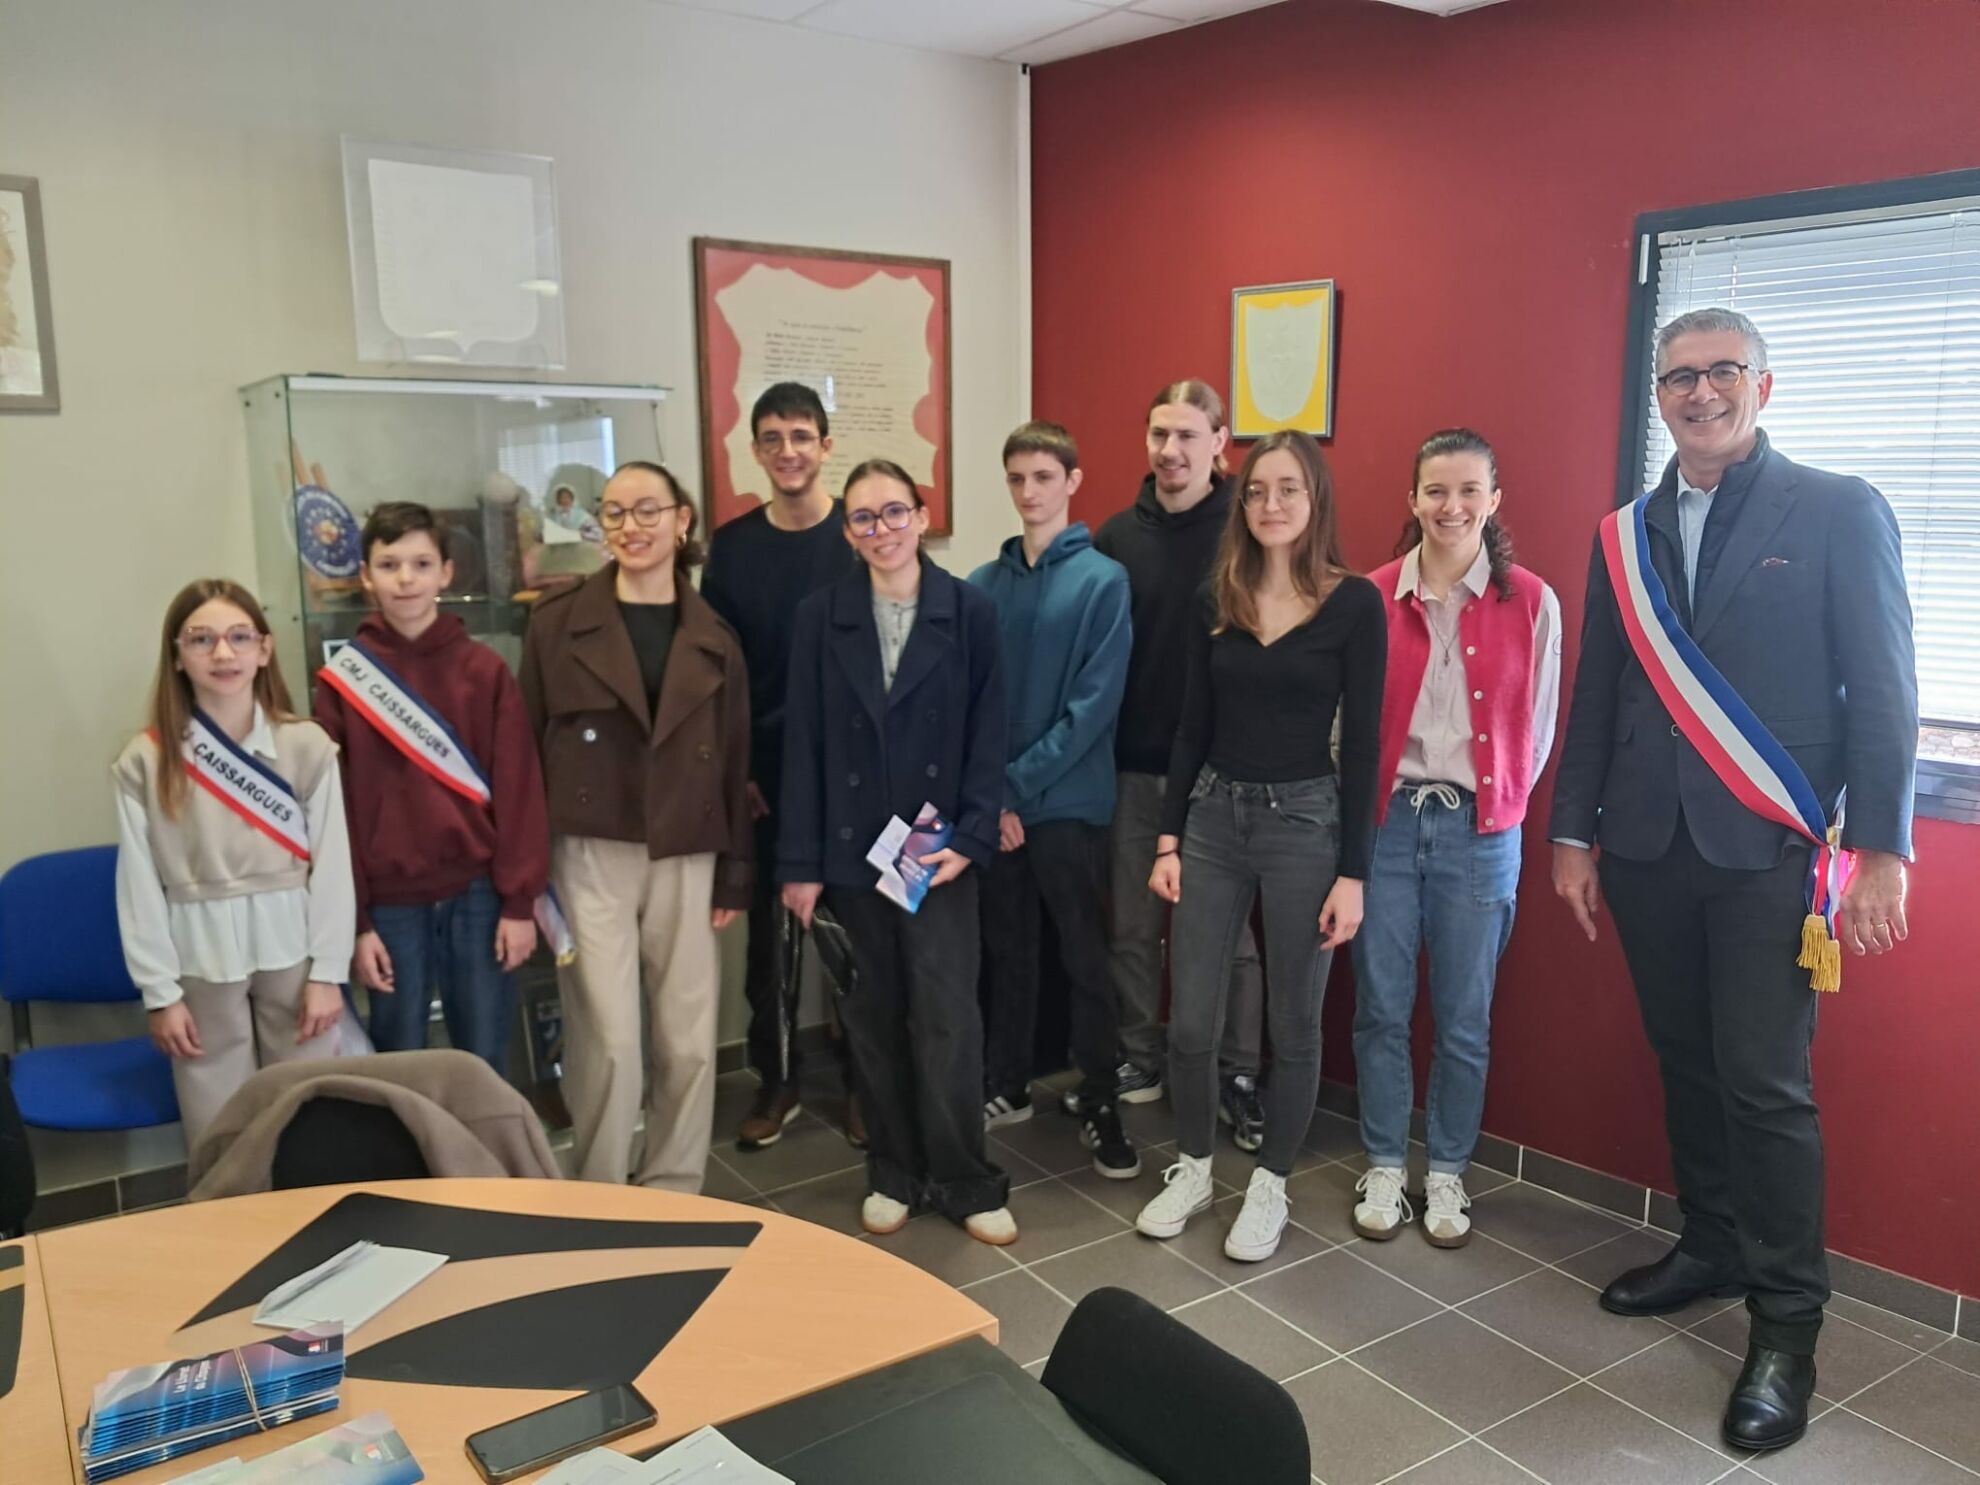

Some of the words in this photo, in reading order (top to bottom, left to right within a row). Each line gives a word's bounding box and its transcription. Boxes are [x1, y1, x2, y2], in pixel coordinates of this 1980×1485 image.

[339, 657, 368, 682] CMJ
[368, 683, 450, 759] CAISSARGUES
[194, 742, 293, 823] CAISSARGUES
